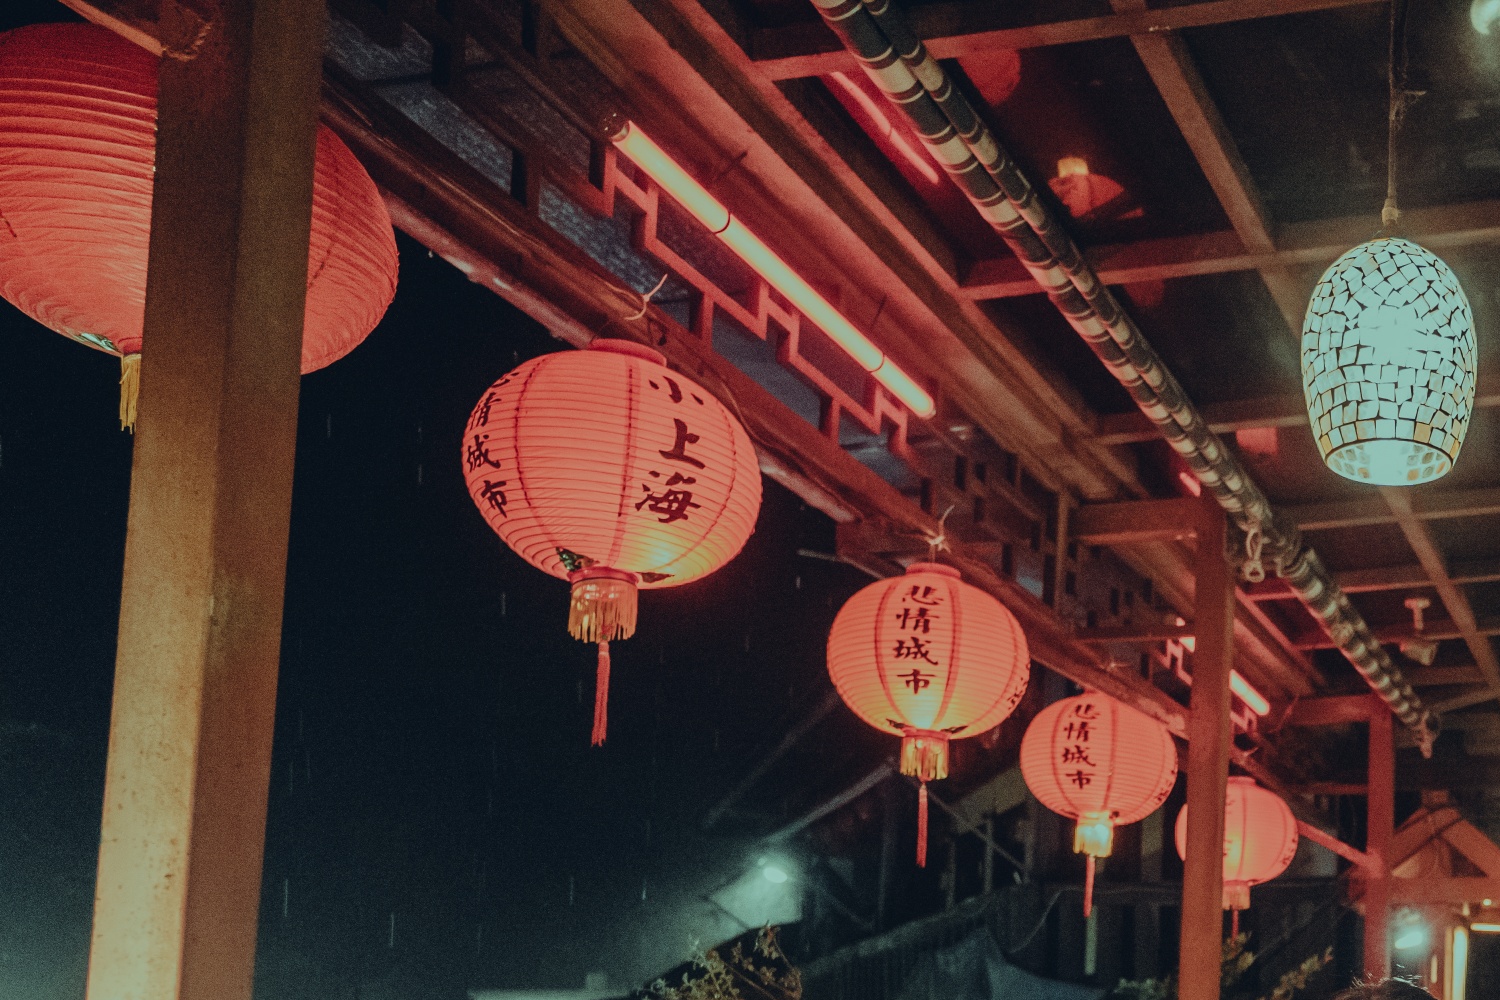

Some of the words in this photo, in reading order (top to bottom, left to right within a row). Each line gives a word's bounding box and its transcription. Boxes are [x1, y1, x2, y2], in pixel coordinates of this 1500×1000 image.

[634, 374, 706, 524] 小上海
[893, 585, 944, 695] 悲情城市
[1062, 703, 1100, 790] 悲情城市
